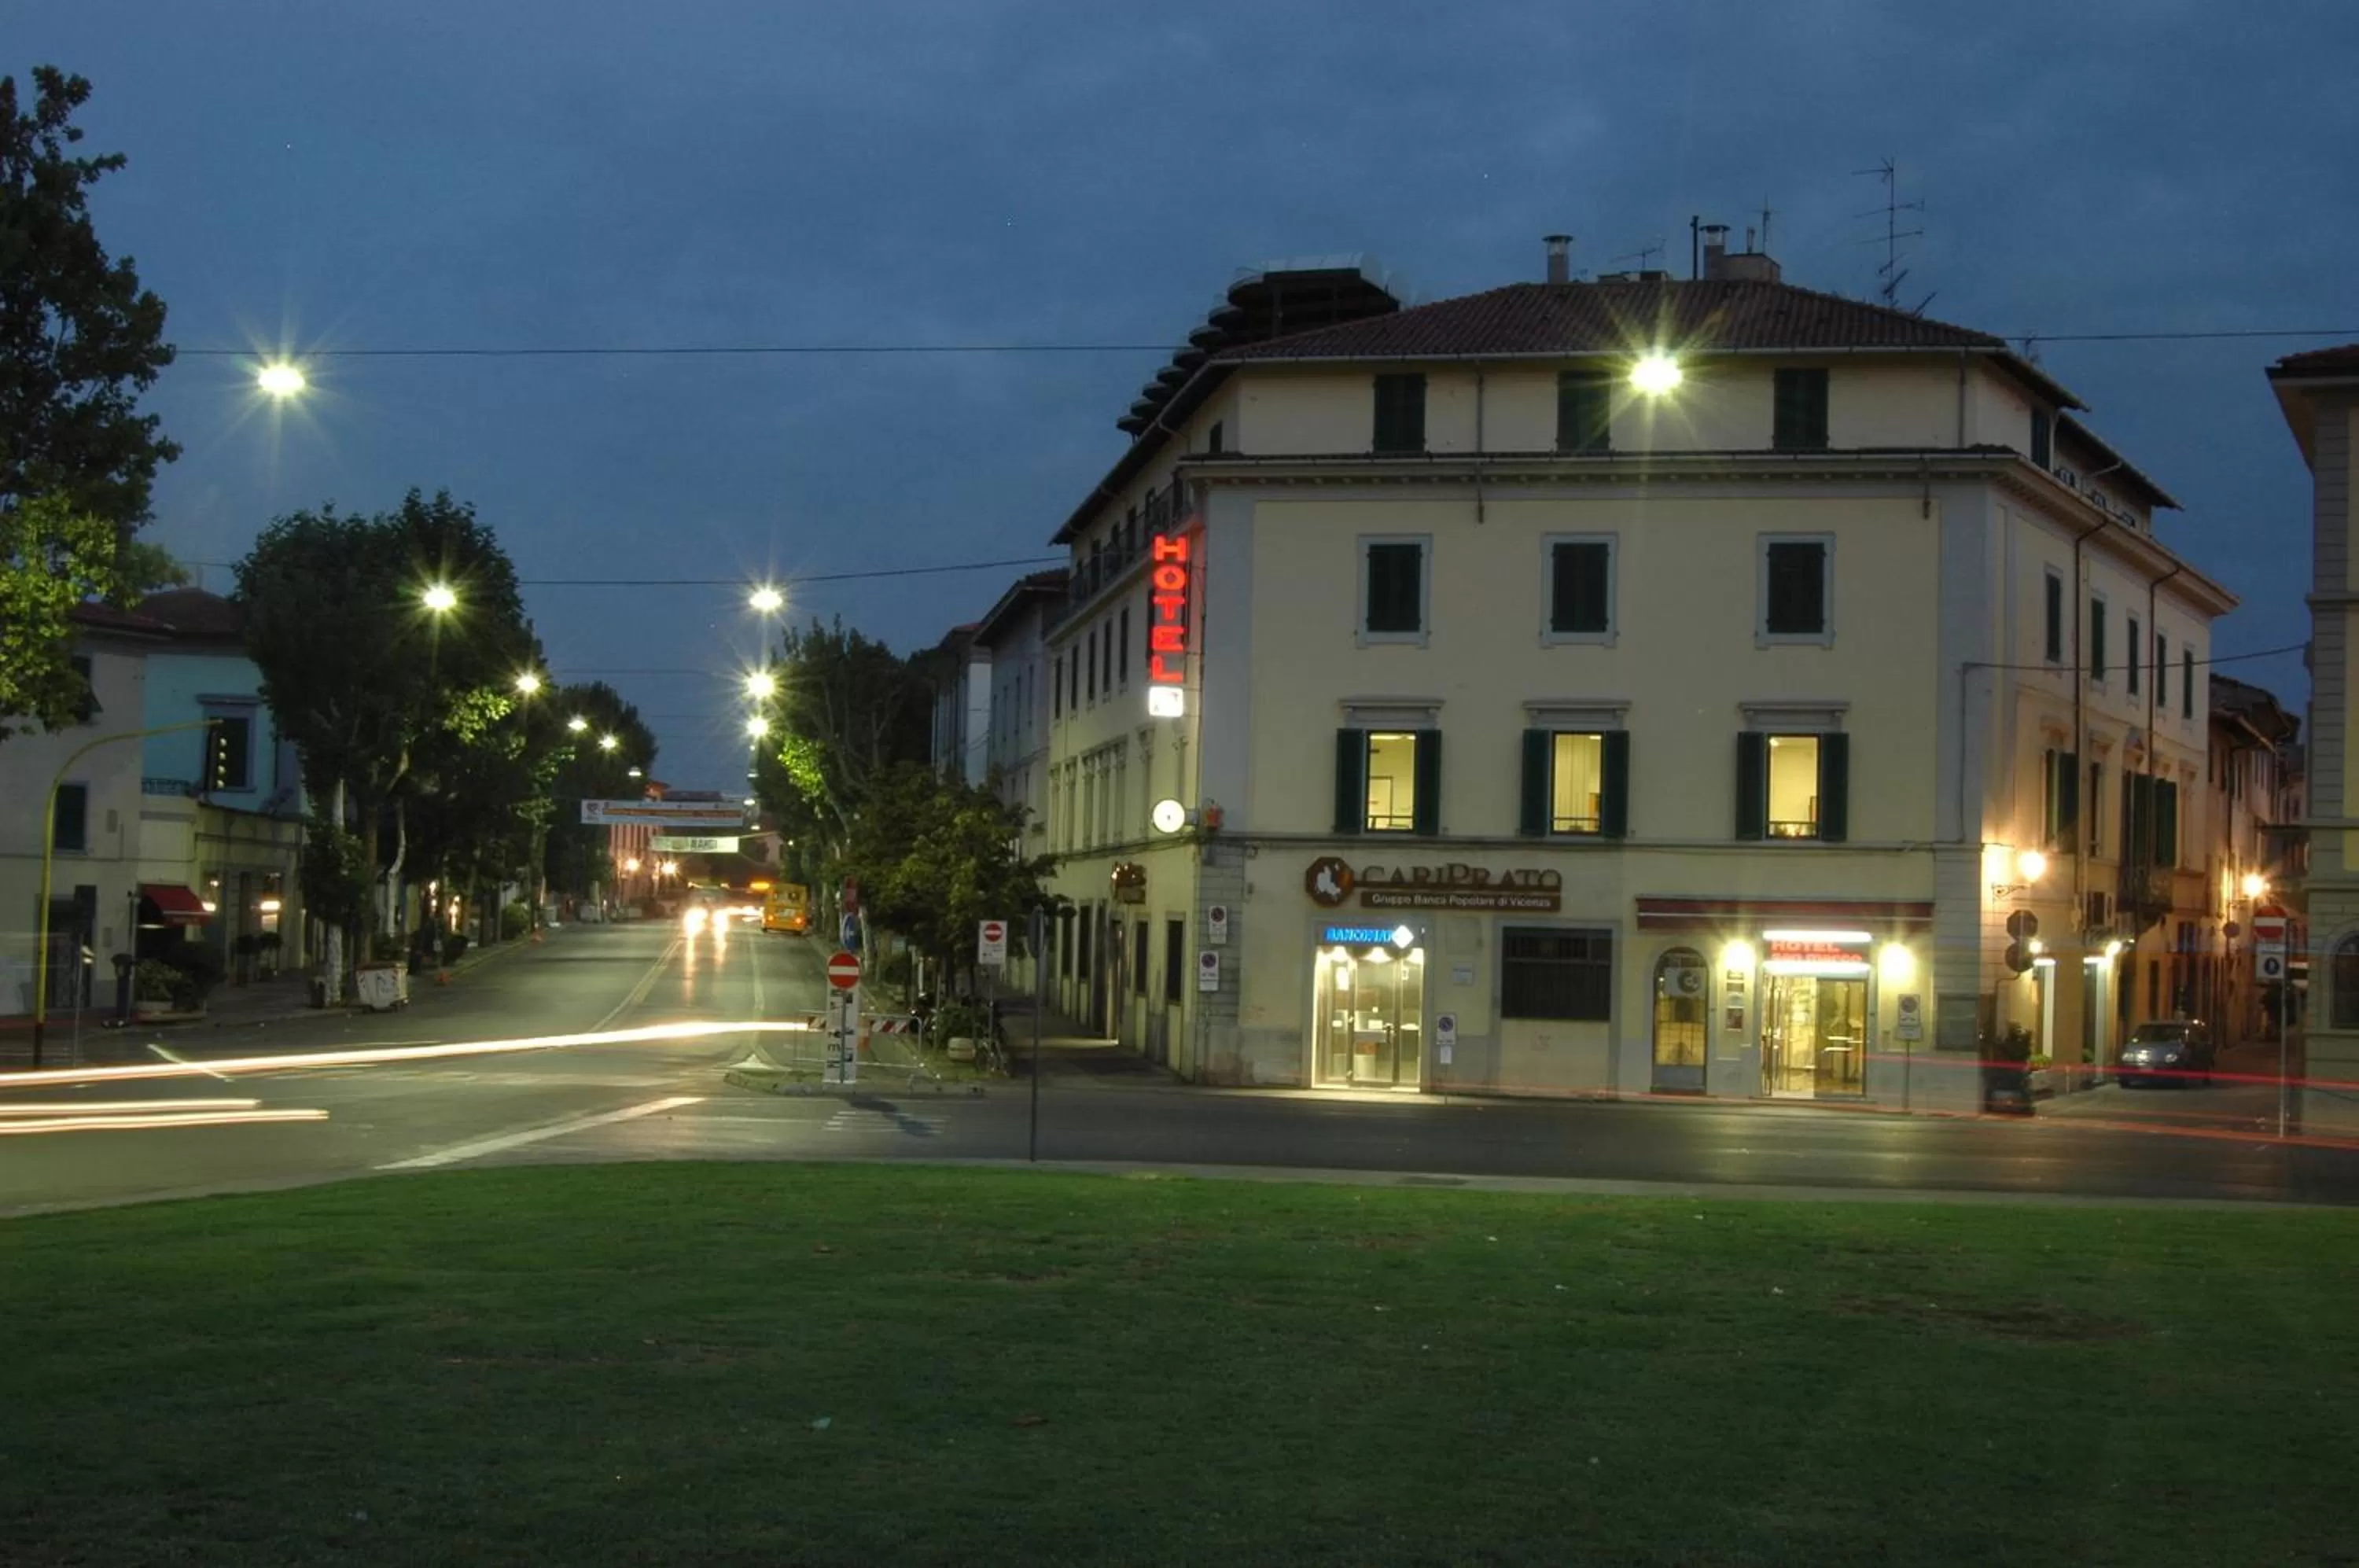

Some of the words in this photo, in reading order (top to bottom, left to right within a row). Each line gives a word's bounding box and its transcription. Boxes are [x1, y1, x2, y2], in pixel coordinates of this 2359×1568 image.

[1152, 534, 1187, 683] HOTEL
[1371, 893, 1411, 906] Gruppo
[1415, 893, 1446, 904] Banca
[1450, 894, 1494, 907] Popolare
[1497, 895, 1507, 906] di
[1509, 895, 1551, 907] Vicenza
[1771, 940, 1841, 952] HOTEL
